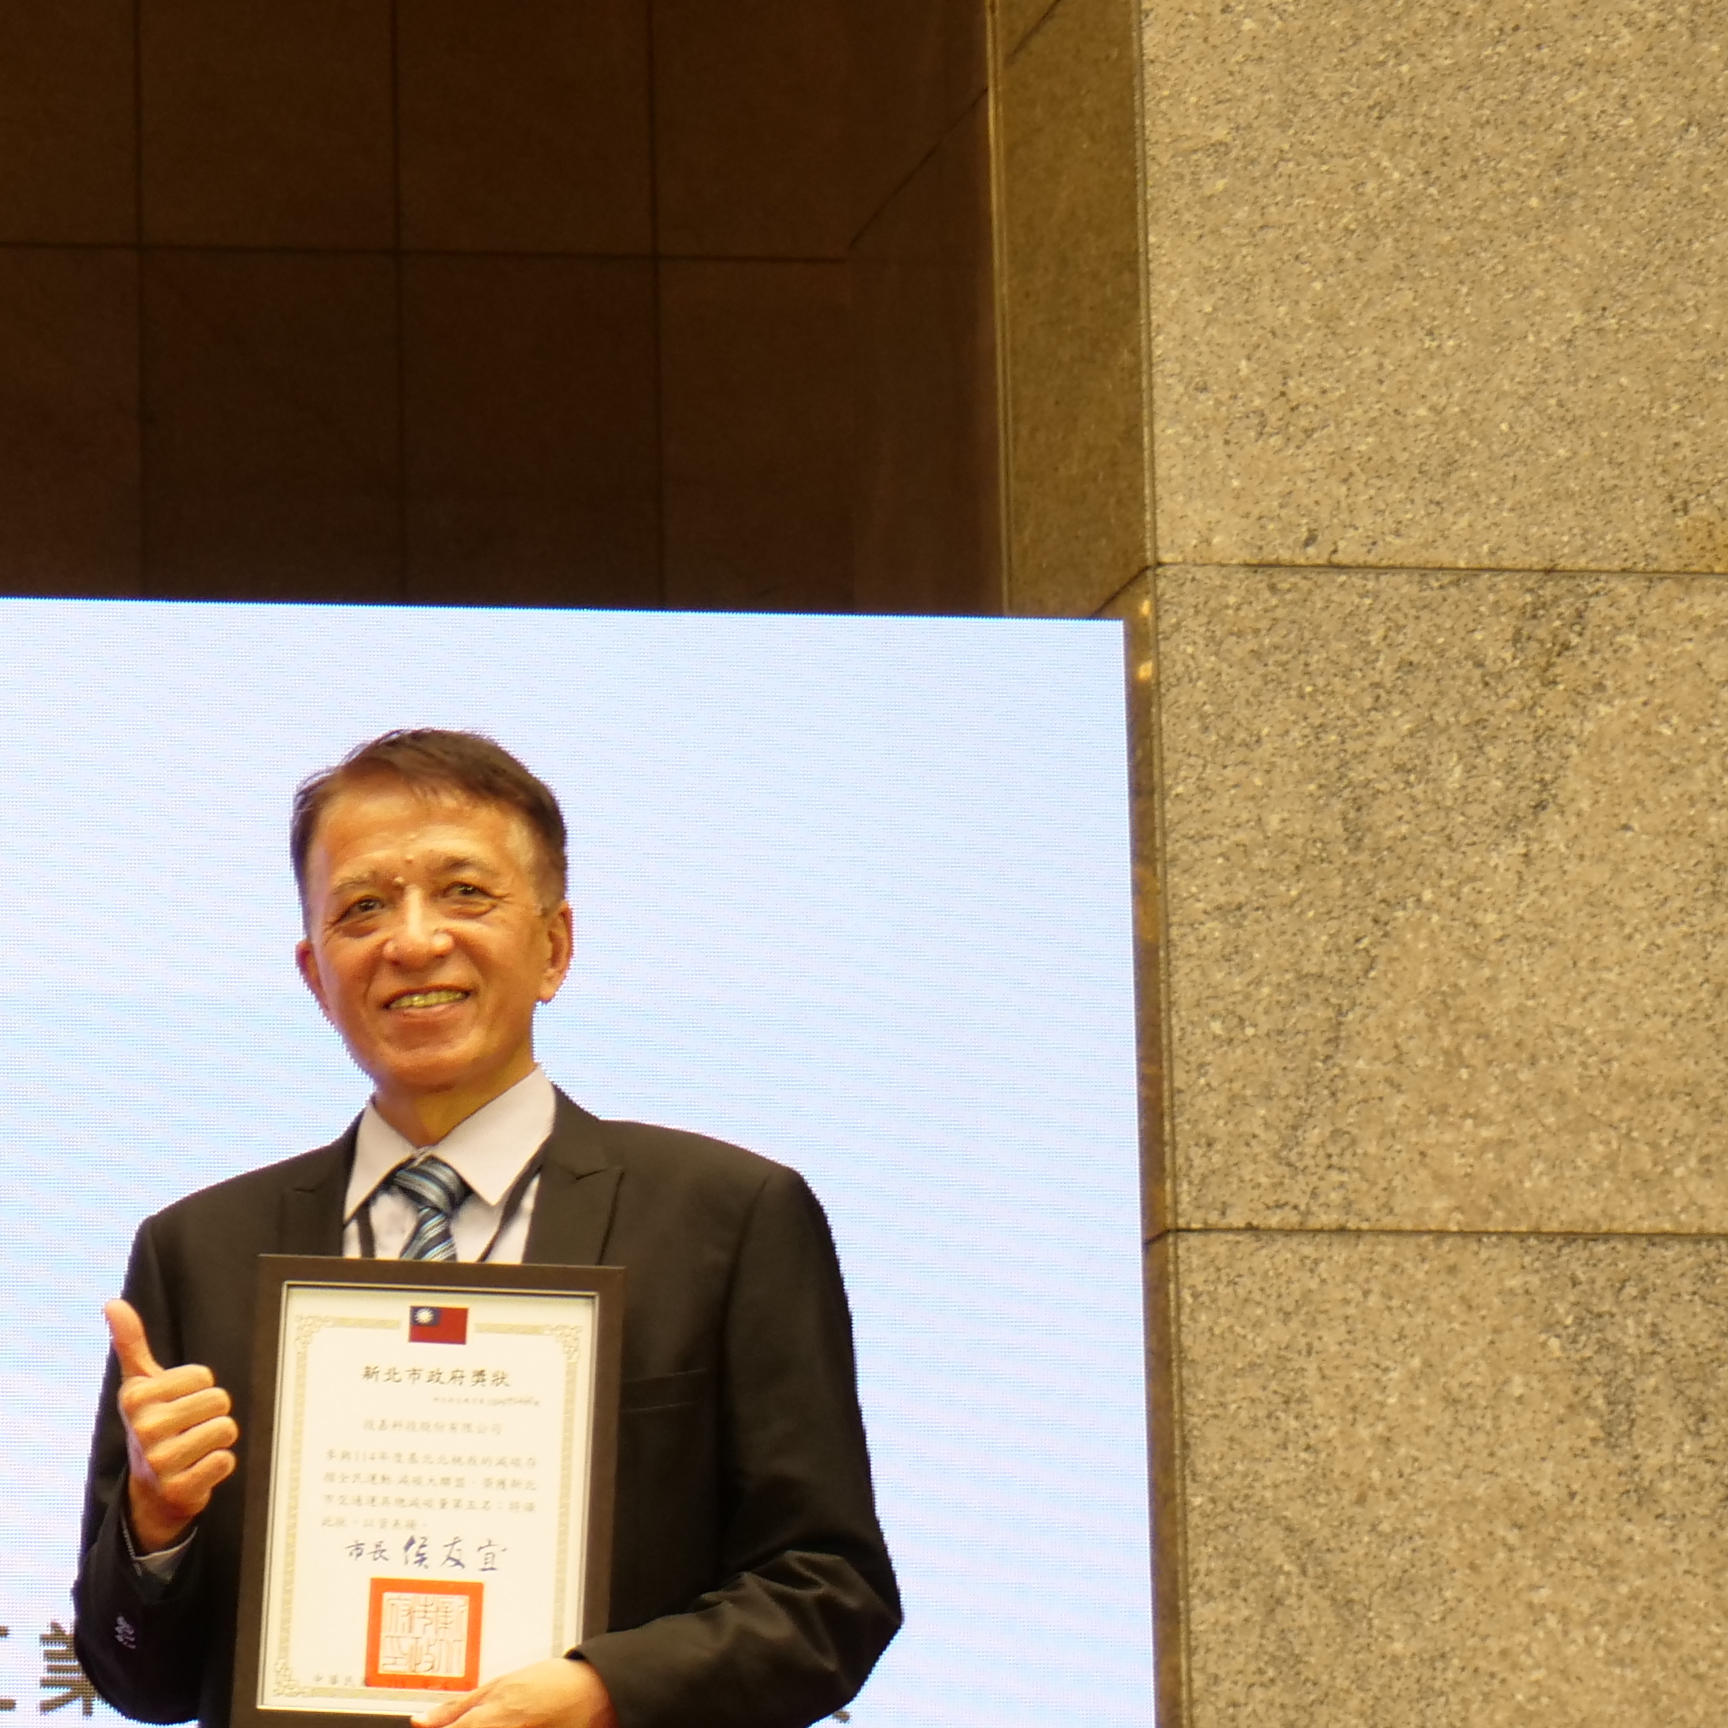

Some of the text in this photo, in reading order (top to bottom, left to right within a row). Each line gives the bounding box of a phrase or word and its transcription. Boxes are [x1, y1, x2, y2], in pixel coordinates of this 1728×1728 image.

[361, 1365, 511, 1388] 新北市政府獎狀
